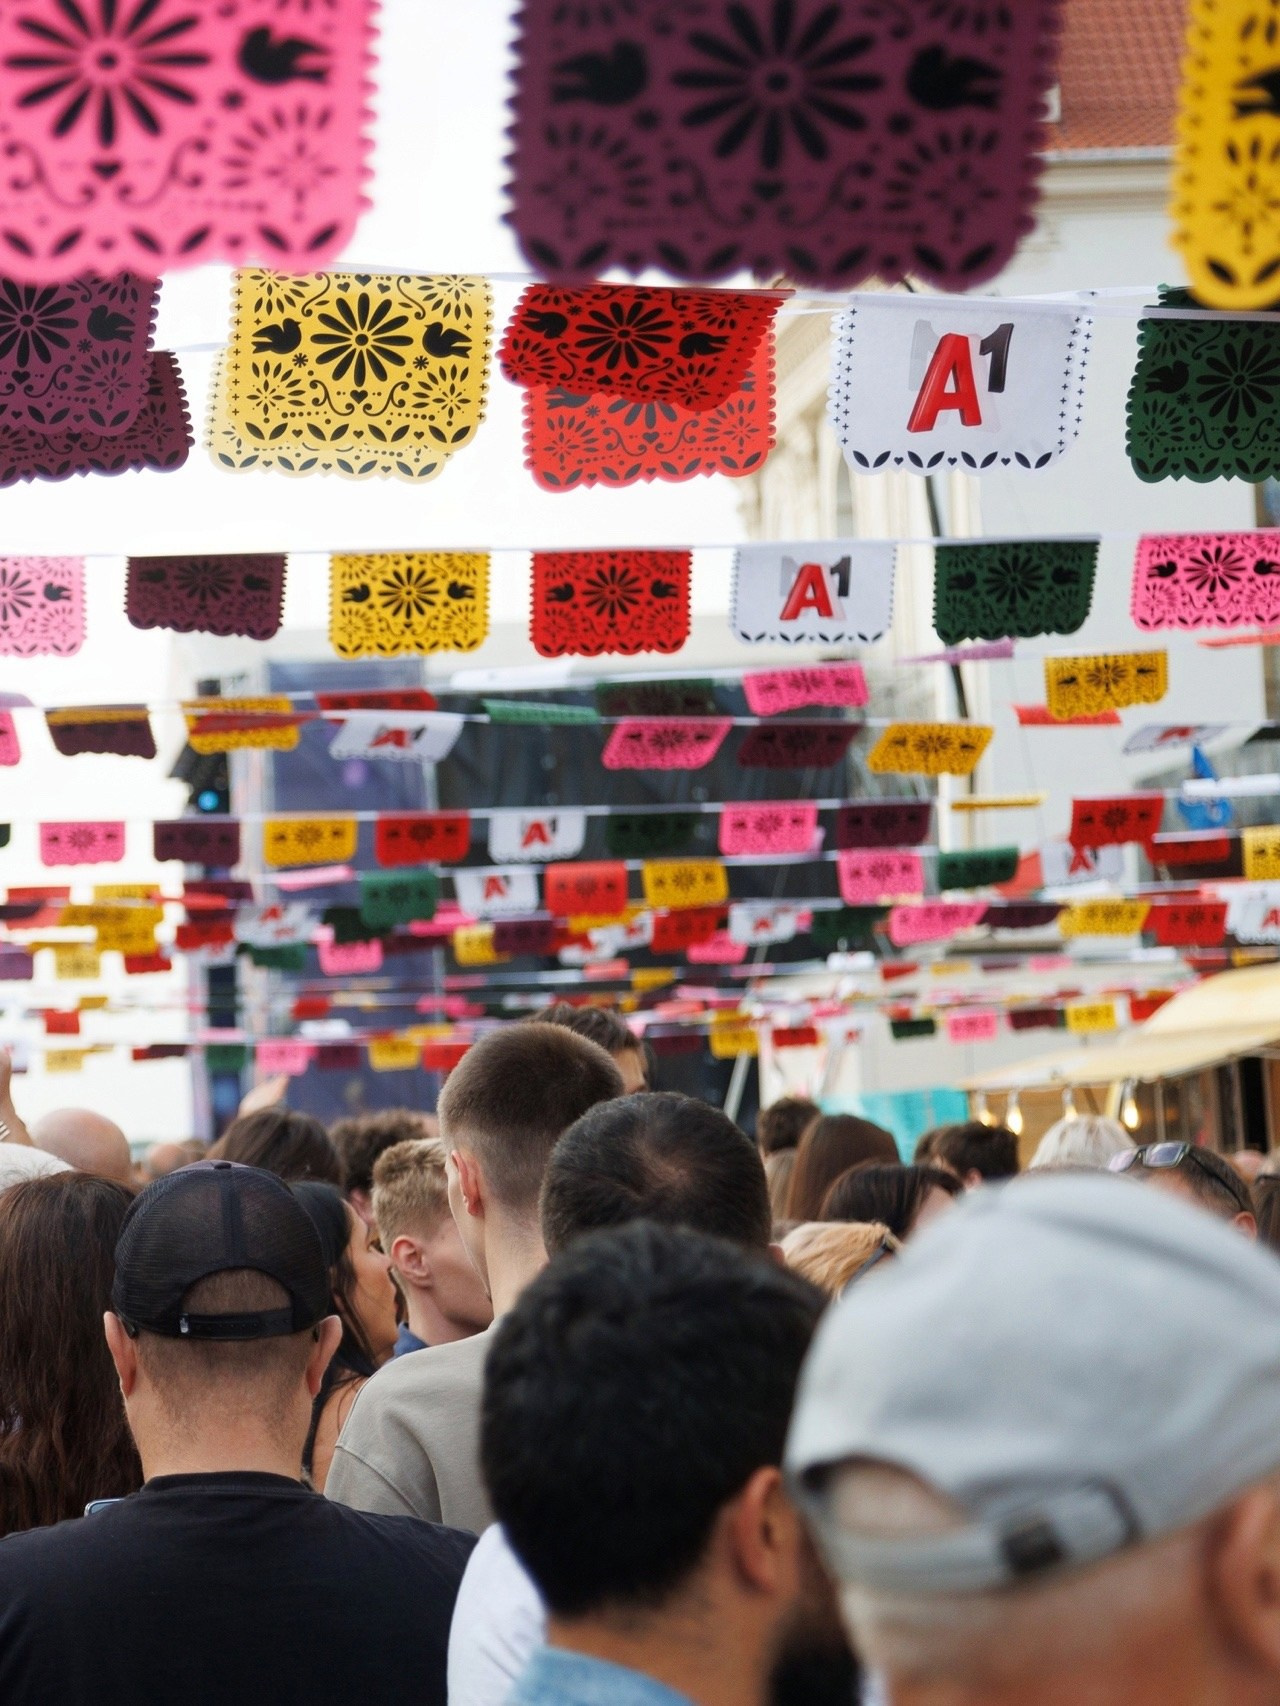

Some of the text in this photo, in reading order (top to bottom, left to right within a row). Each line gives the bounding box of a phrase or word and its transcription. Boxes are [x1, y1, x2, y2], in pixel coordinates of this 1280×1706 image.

[907, 323, 1014, 433] A1
[780, 556, 851, 620] A1
[521, 817, 557, 847] A1
